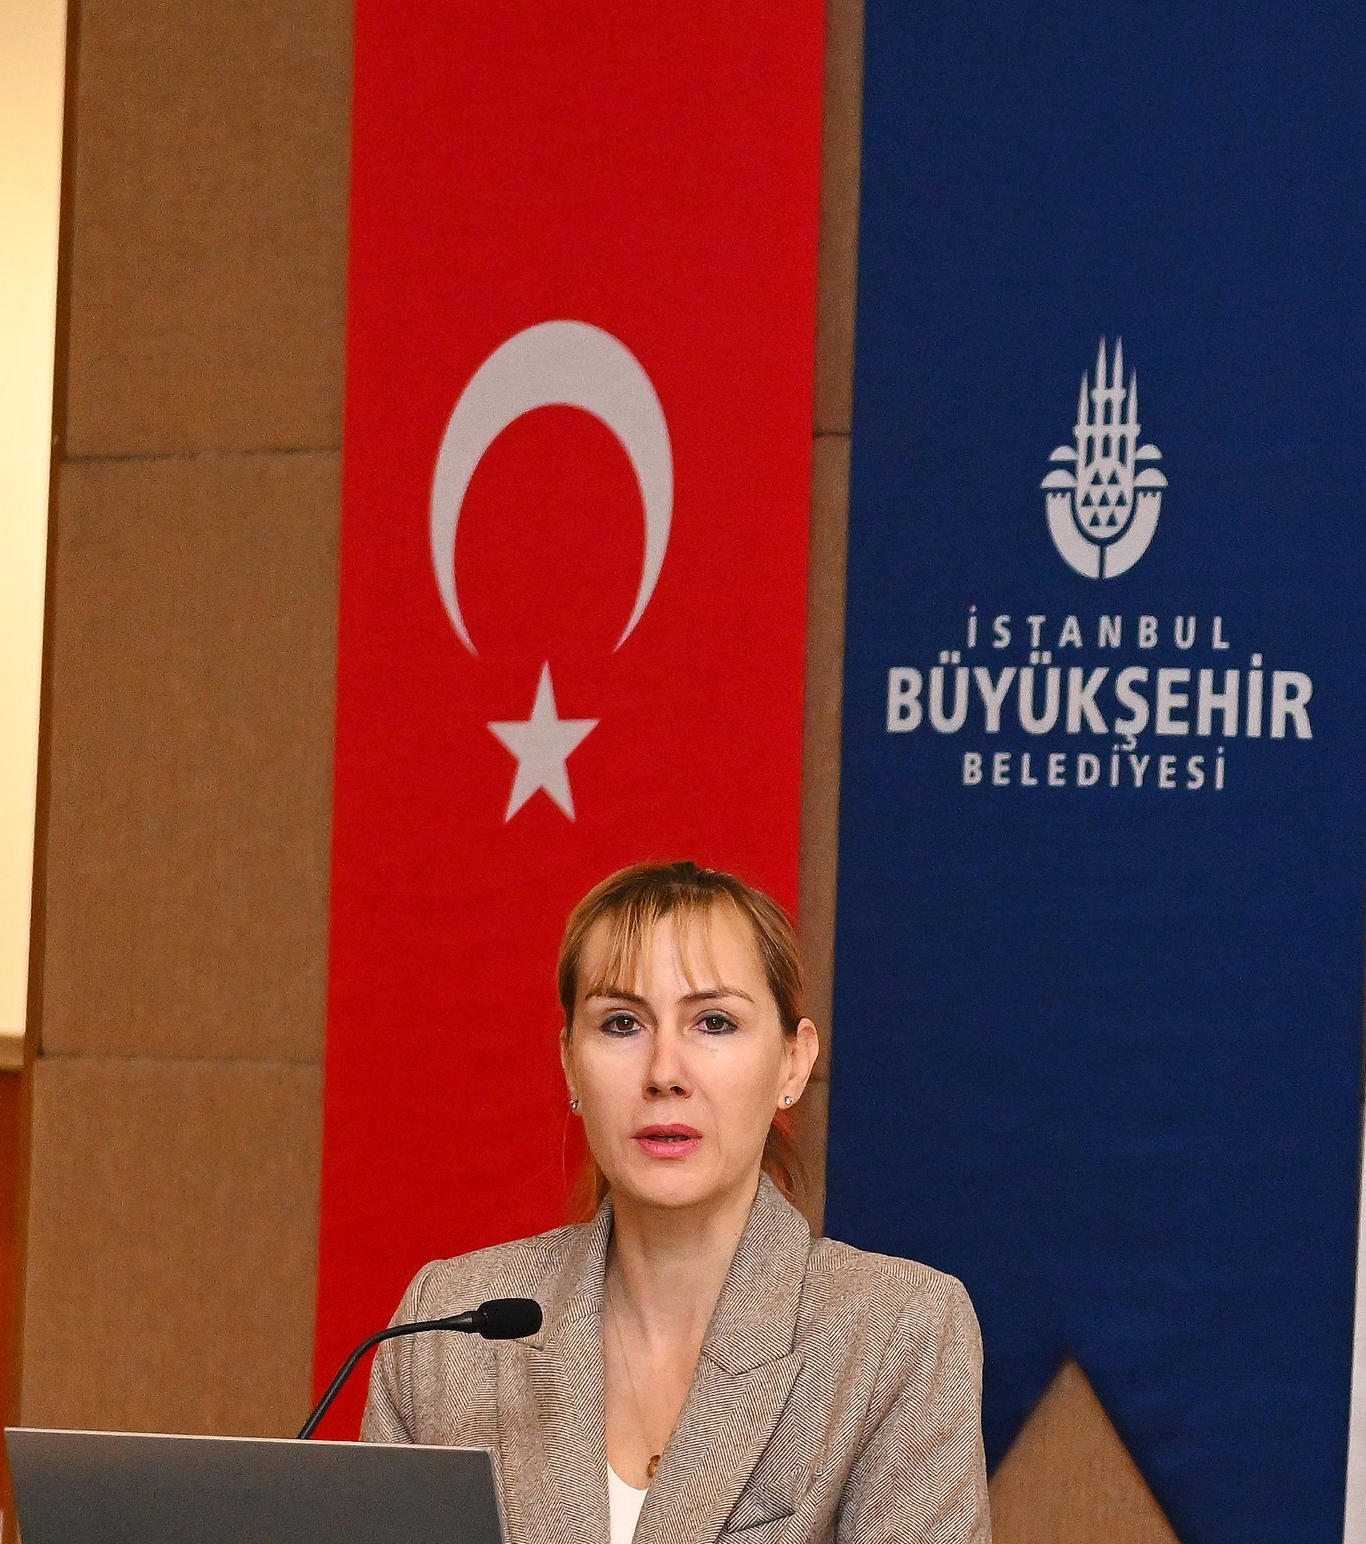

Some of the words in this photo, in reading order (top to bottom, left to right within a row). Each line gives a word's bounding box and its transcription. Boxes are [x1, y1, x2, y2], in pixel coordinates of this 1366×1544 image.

[966, 605, 1230, 650] İSTANBUL
[886, 650, 1313, 750] BÜYÜKŞEHİR
[962, 744, 1226, 790] BELEDİYESİ
